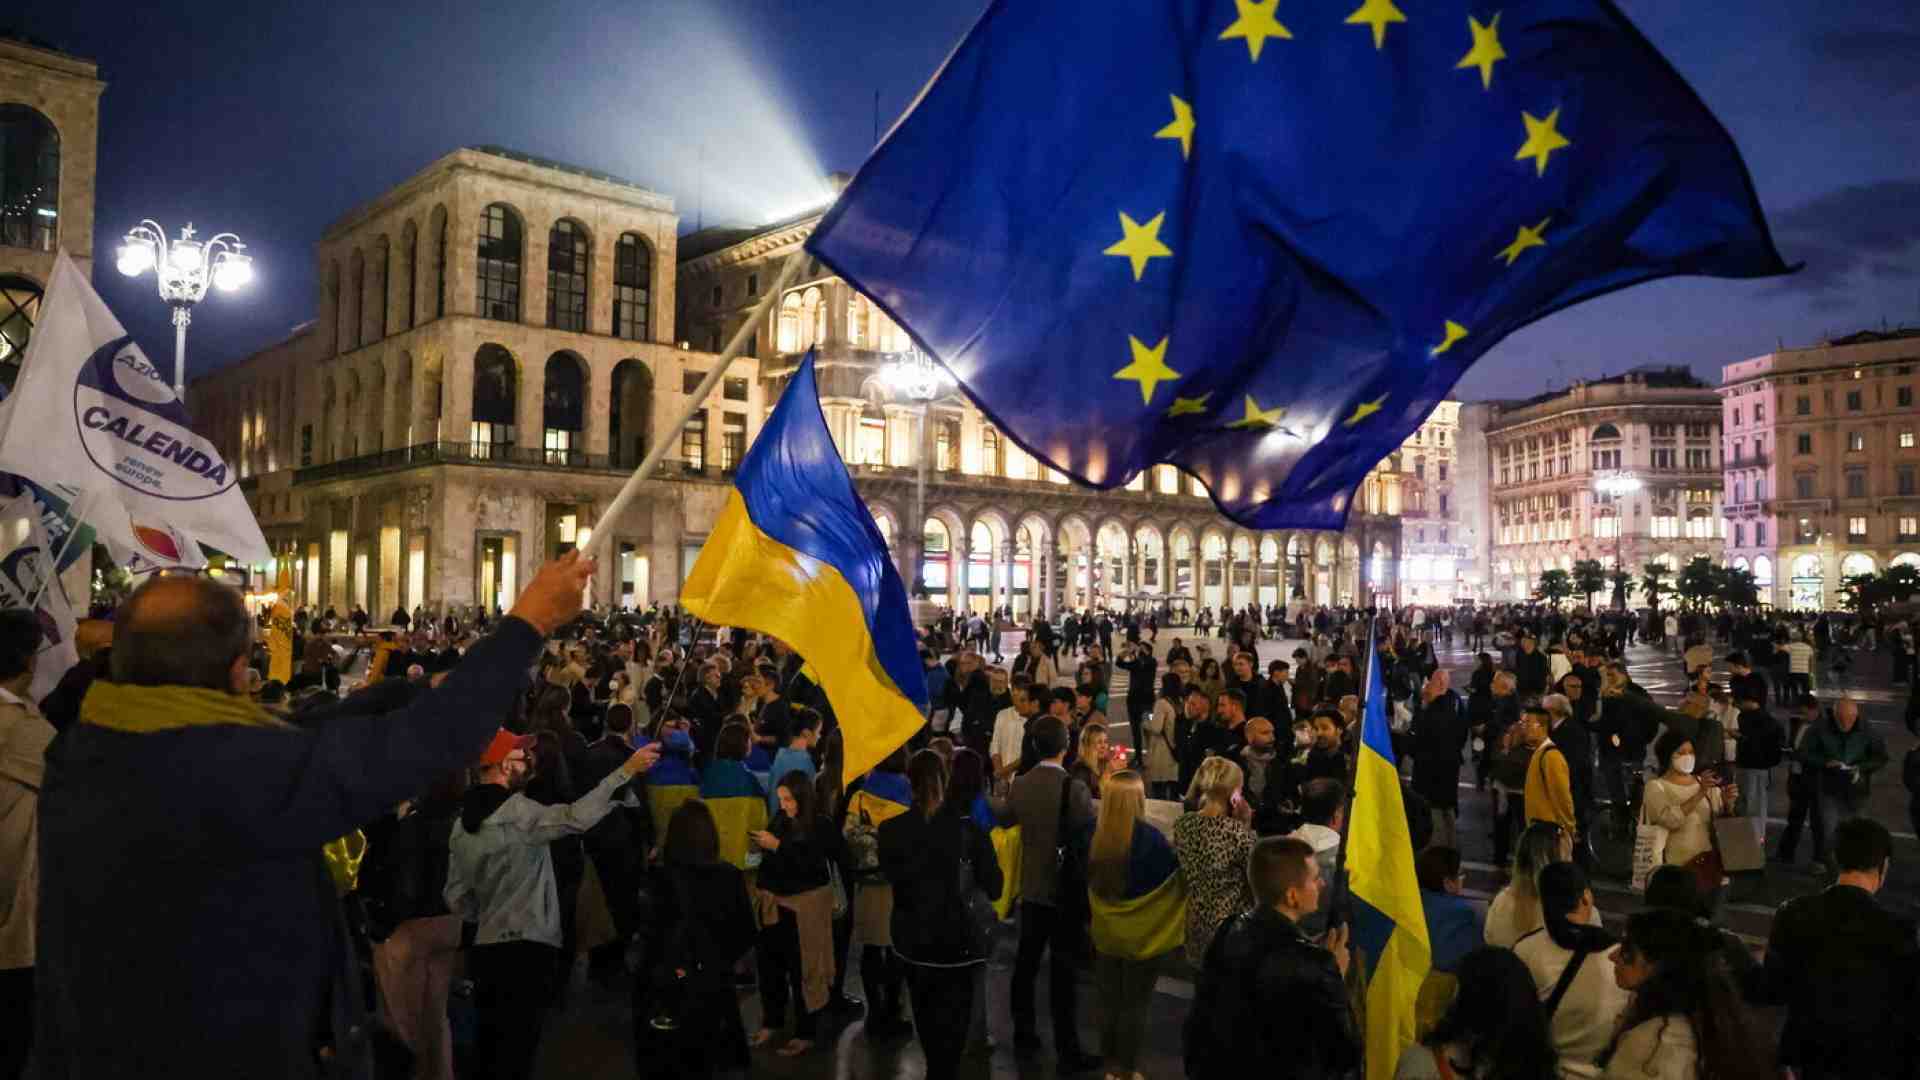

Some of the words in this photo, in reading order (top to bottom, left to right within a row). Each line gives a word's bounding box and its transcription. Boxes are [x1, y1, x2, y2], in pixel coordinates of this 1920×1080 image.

[117, 355, 161, 380] AZIO
[83, 406, 227, 486] CALENDA
[123, 456, 165, 477] renew
